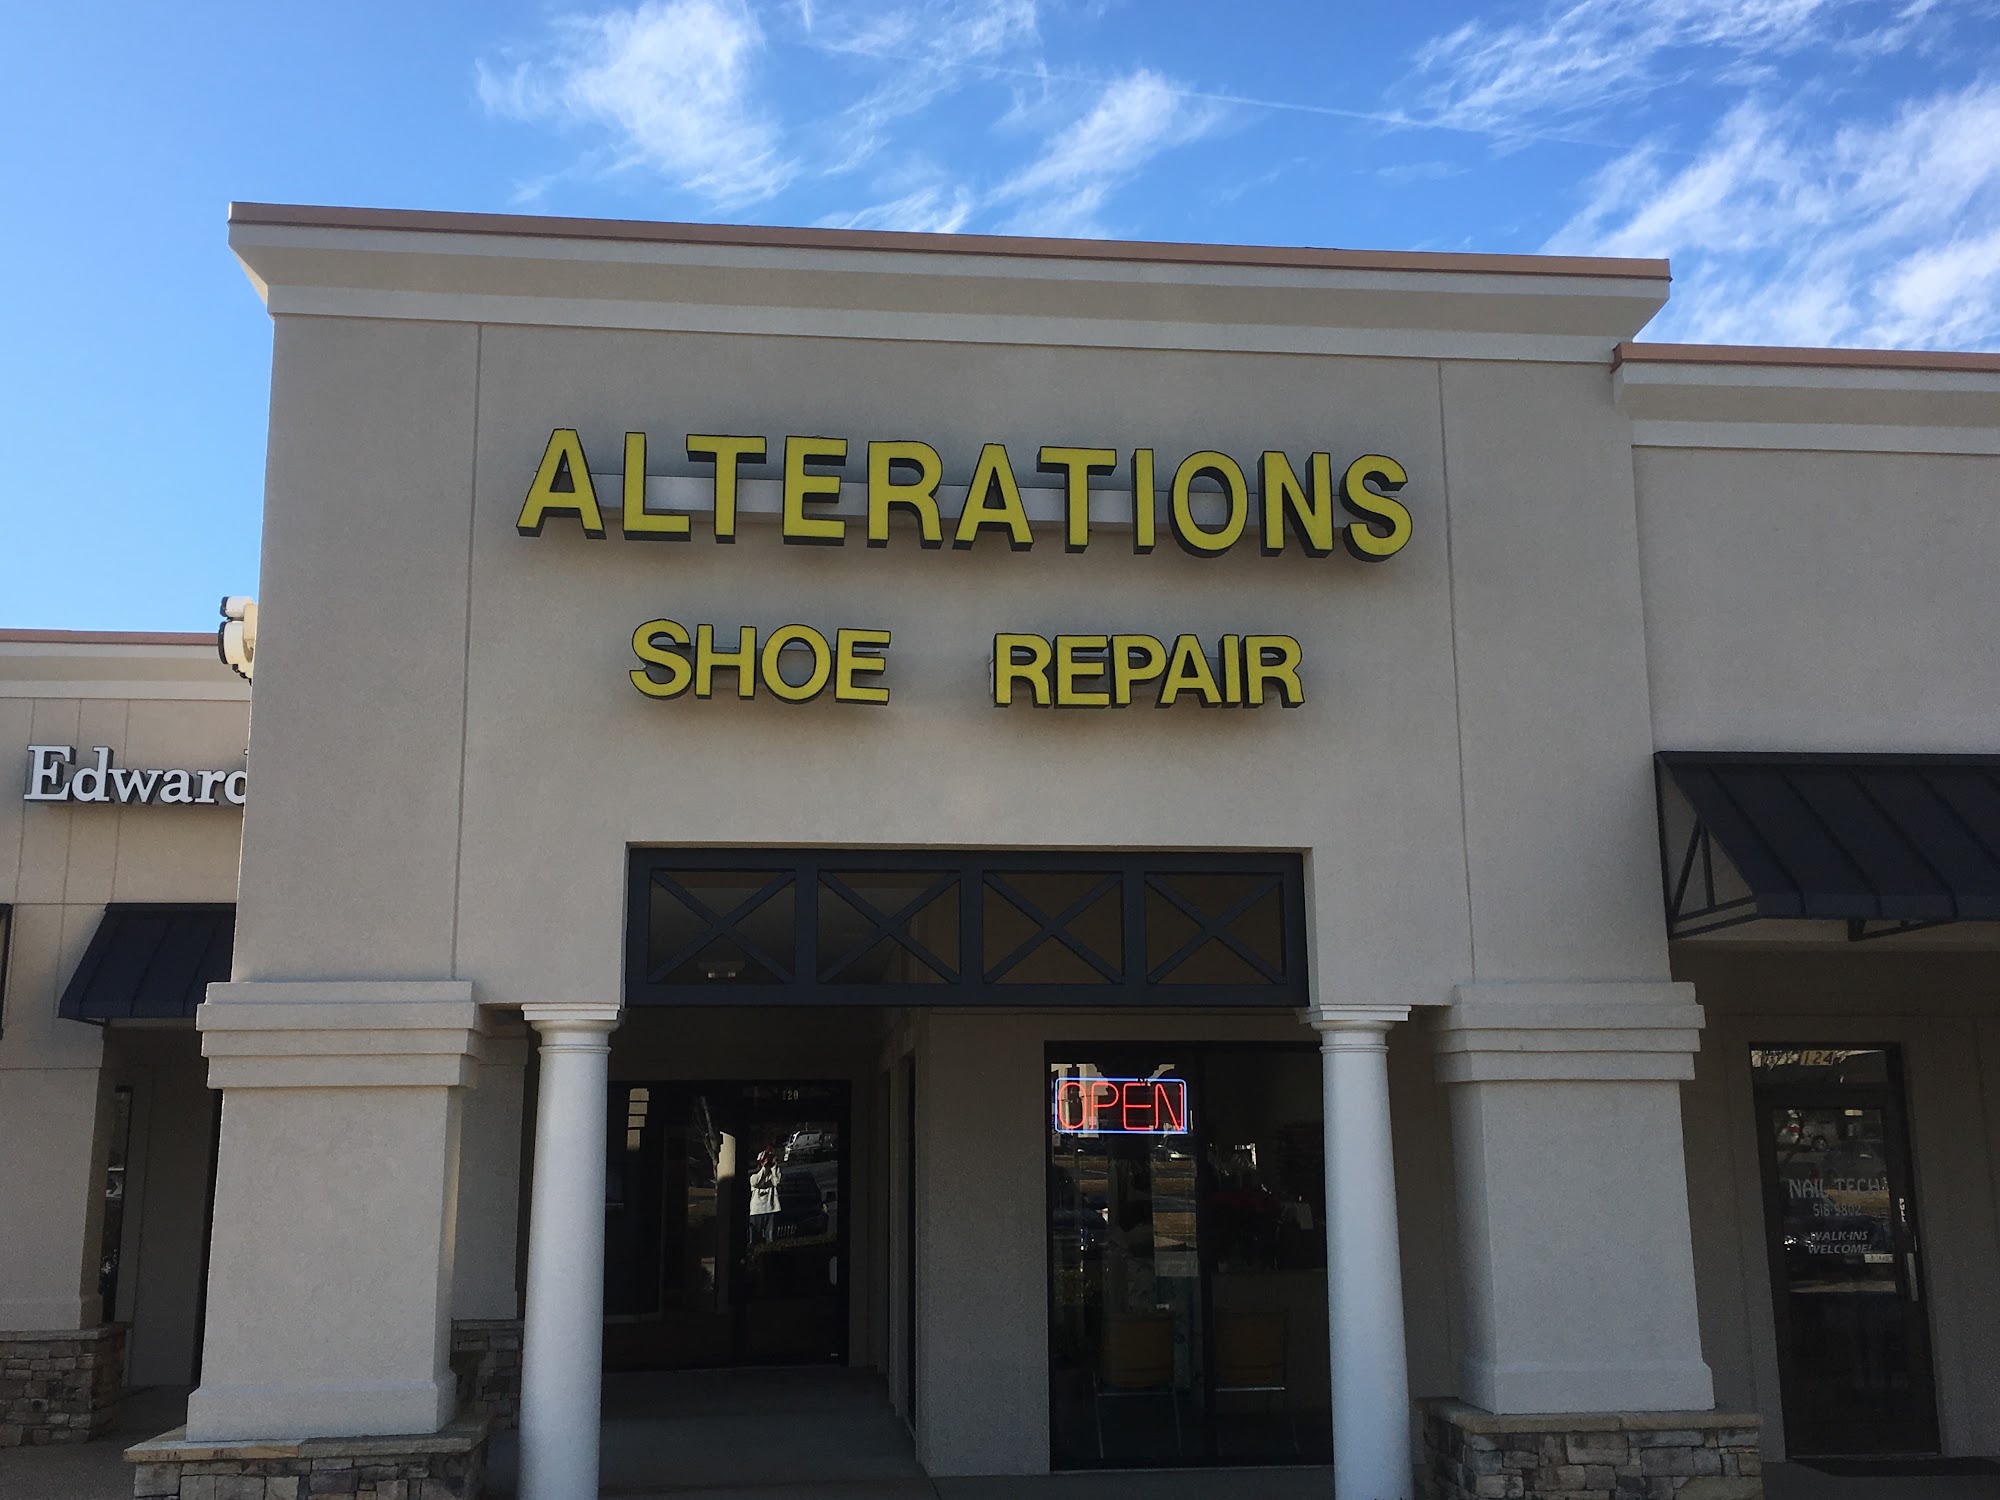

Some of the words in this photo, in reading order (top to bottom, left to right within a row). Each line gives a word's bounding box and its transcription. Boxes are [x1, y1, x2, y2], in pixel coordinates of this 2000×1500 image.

[516, 428, 1413, 559] ALTERATIONS
[629, 618, 891, 704] SHOE
[994, 632, 1305, 707] REPAIR
[1802, 1050, 1834, 1065] 124
[1057, 1081, 1184, 1132] OPEN
[1788, 1178, 1826, 1199] NAIL
[1898, 1197, 1906, 1223] PULL
[1810, 1230, 1868, 1242] WALK-INS
[1808, 1243, 1873, 1255] WELCOME!
